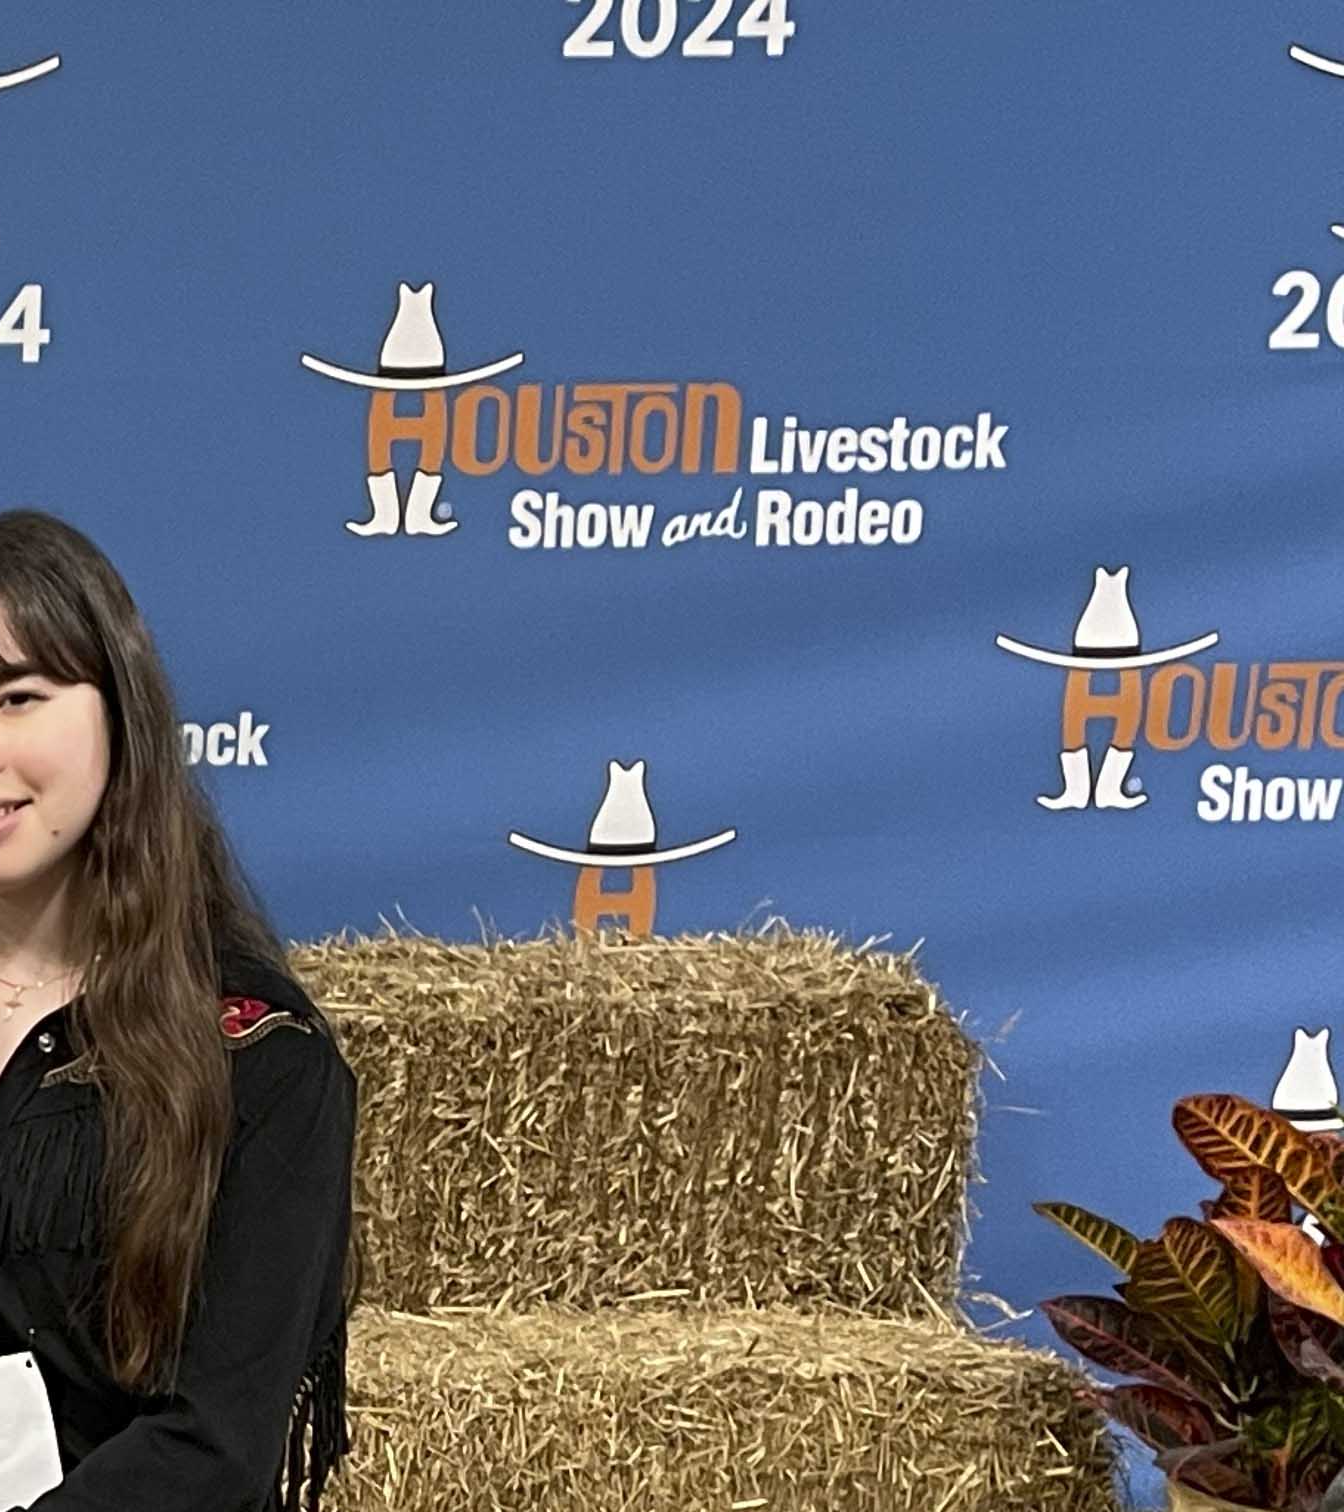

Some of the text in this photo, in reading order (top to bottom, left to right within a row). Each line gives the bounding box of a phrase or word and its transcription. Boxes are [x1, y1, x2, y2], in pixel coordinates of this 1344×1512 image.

[563, 0, 796, 58] 2024
[749, 412, 1009, 476] Livestock
[508, 487, 923, 550] Show and Rodeo
[1197, 764, 1344, 823] Show
